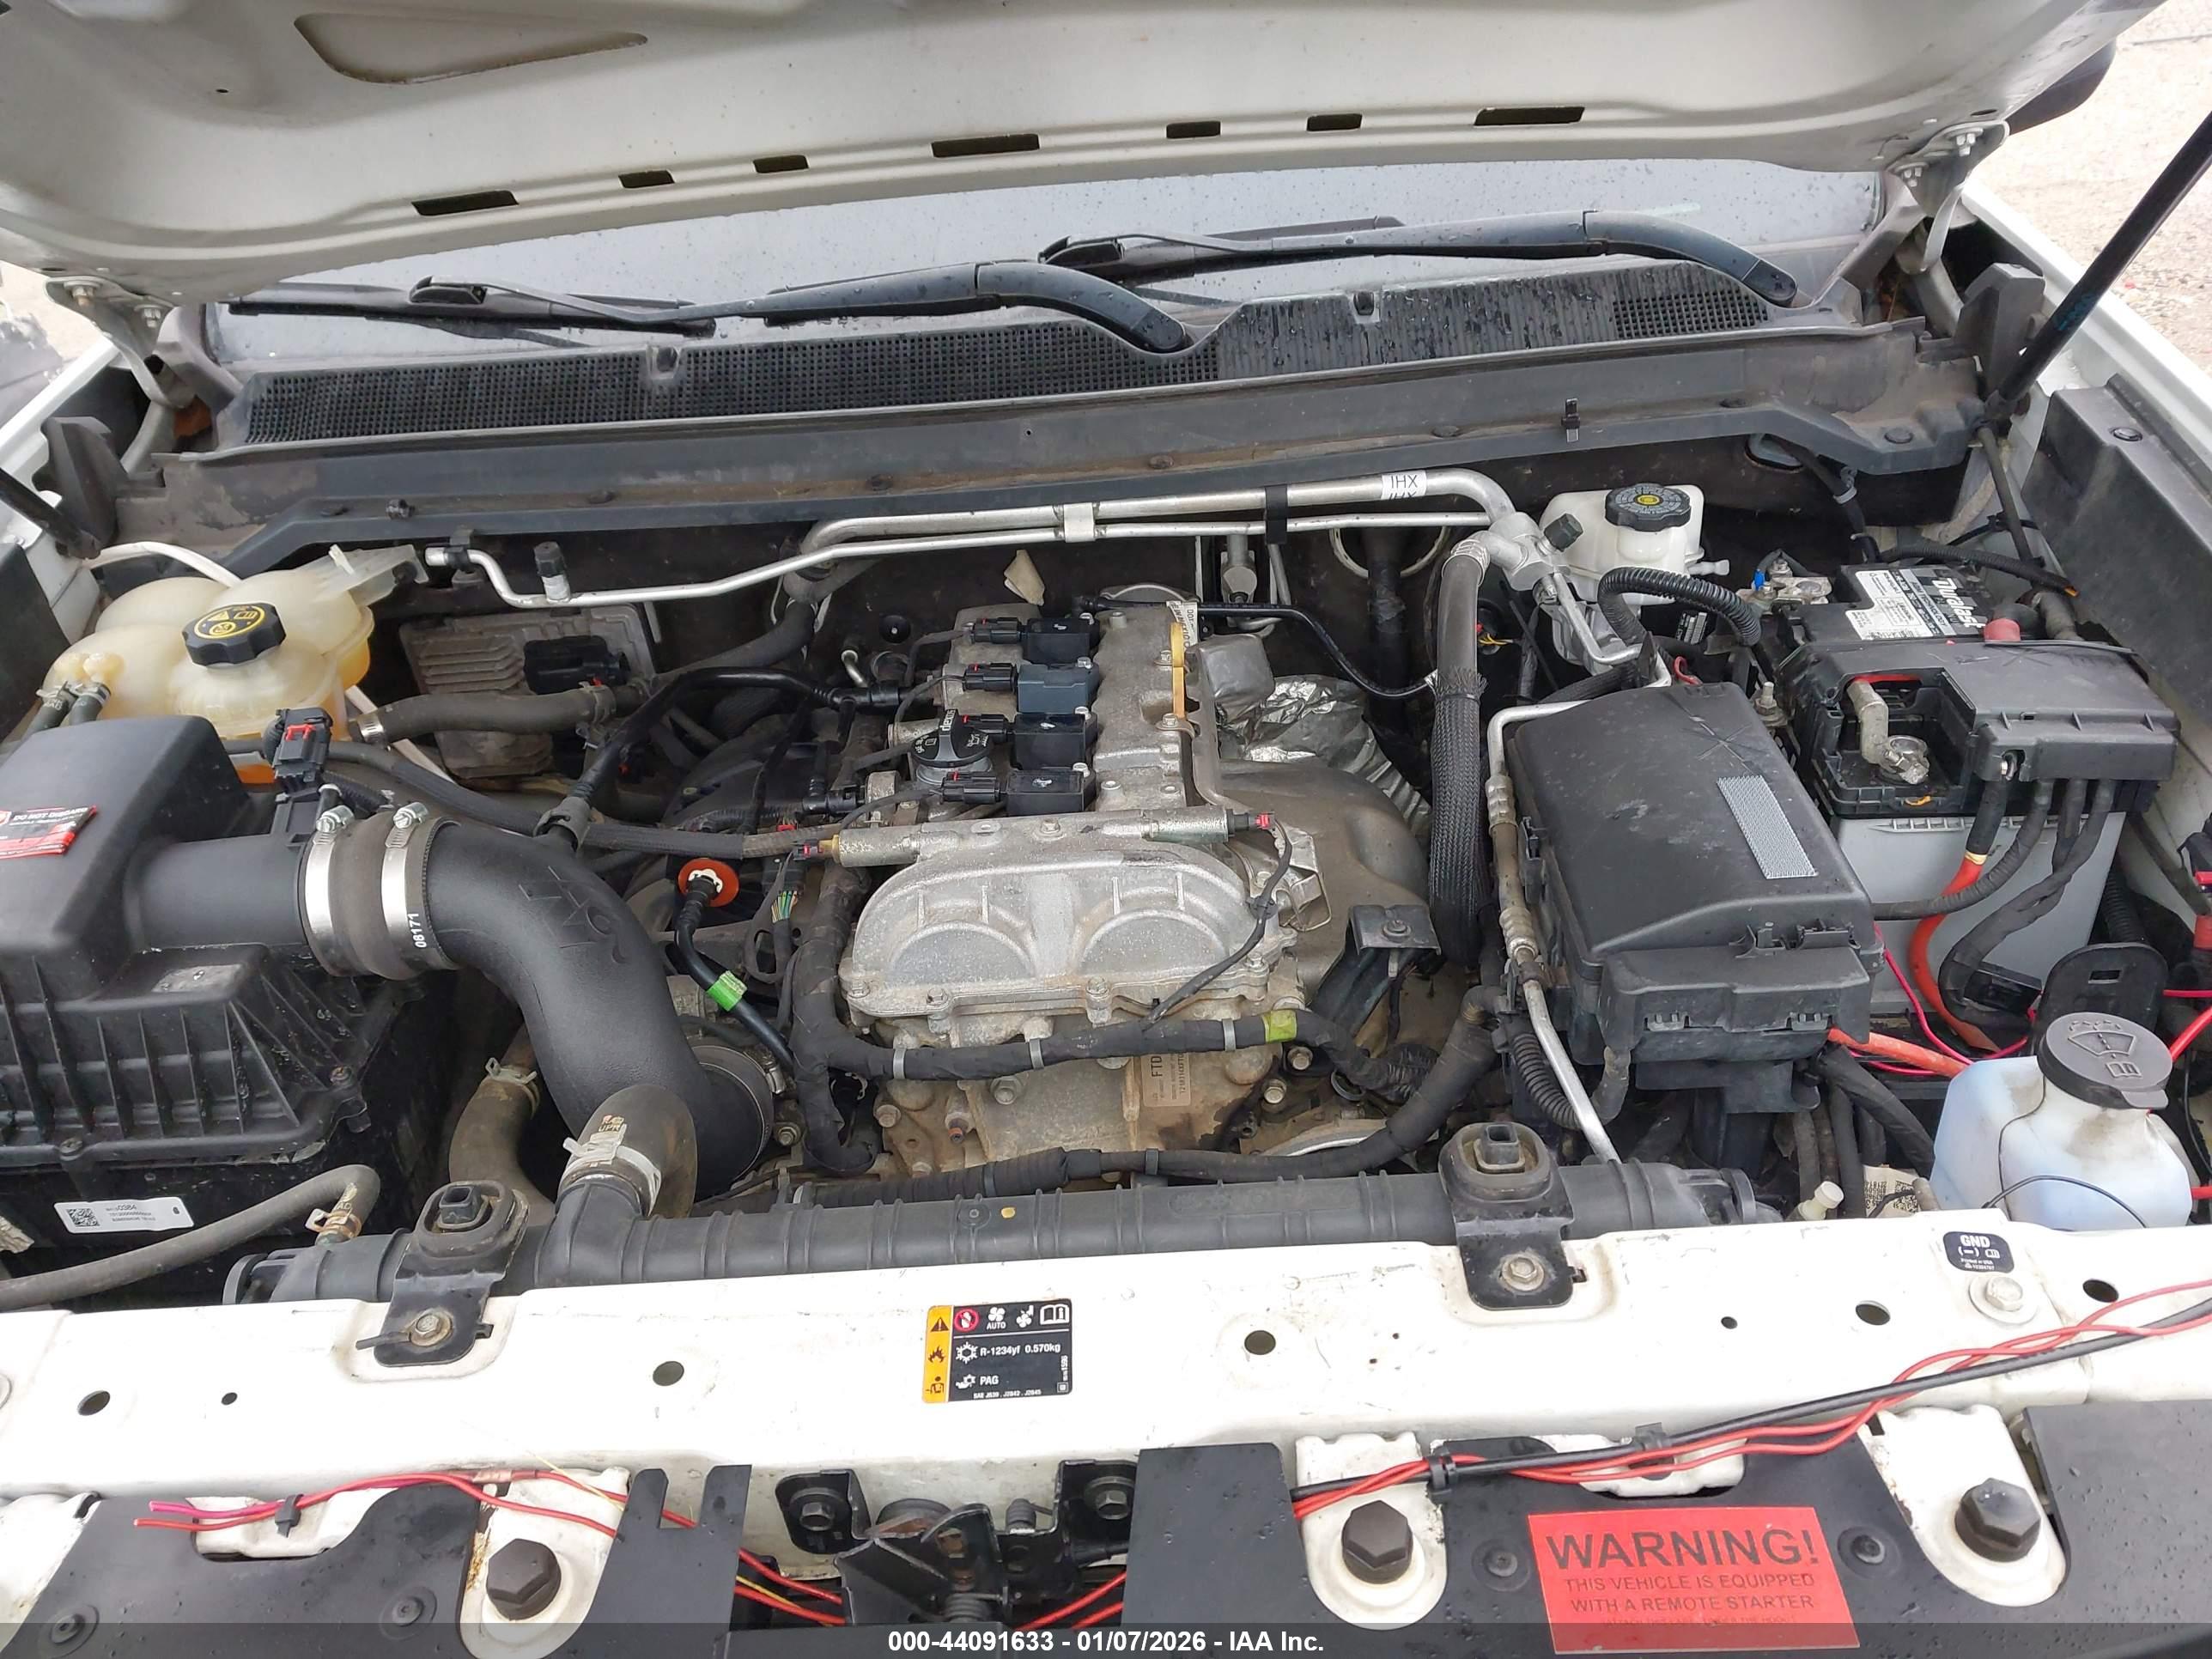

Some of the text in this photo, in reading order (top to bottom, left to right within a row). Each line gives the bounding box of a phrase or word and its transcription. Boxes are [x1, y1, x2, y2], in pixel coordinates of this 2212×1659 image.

[1391, 474, 1418, 488] IHX
[1930, 577, 1986, 628] Duralast
[49, 807, 89, 817] DISCARD
[407, 913, 427, 948] 08171
[1960, 1235, 1990, 1248] GND
[987, 1322, 1006, 1330] AUTO
[980, 1343, 1061, 1358] R-1234yf 0.570kg
[980, 1376, 1000, 1385] PAG
[1545, 1528, 1820, 1570] WARNING!
[1566, 1572, 1815, 1593] THIS VEHICLE IS EQUIPPED
[1570, 1595, 1814, 1613] WITH A REMOTE STARTER
